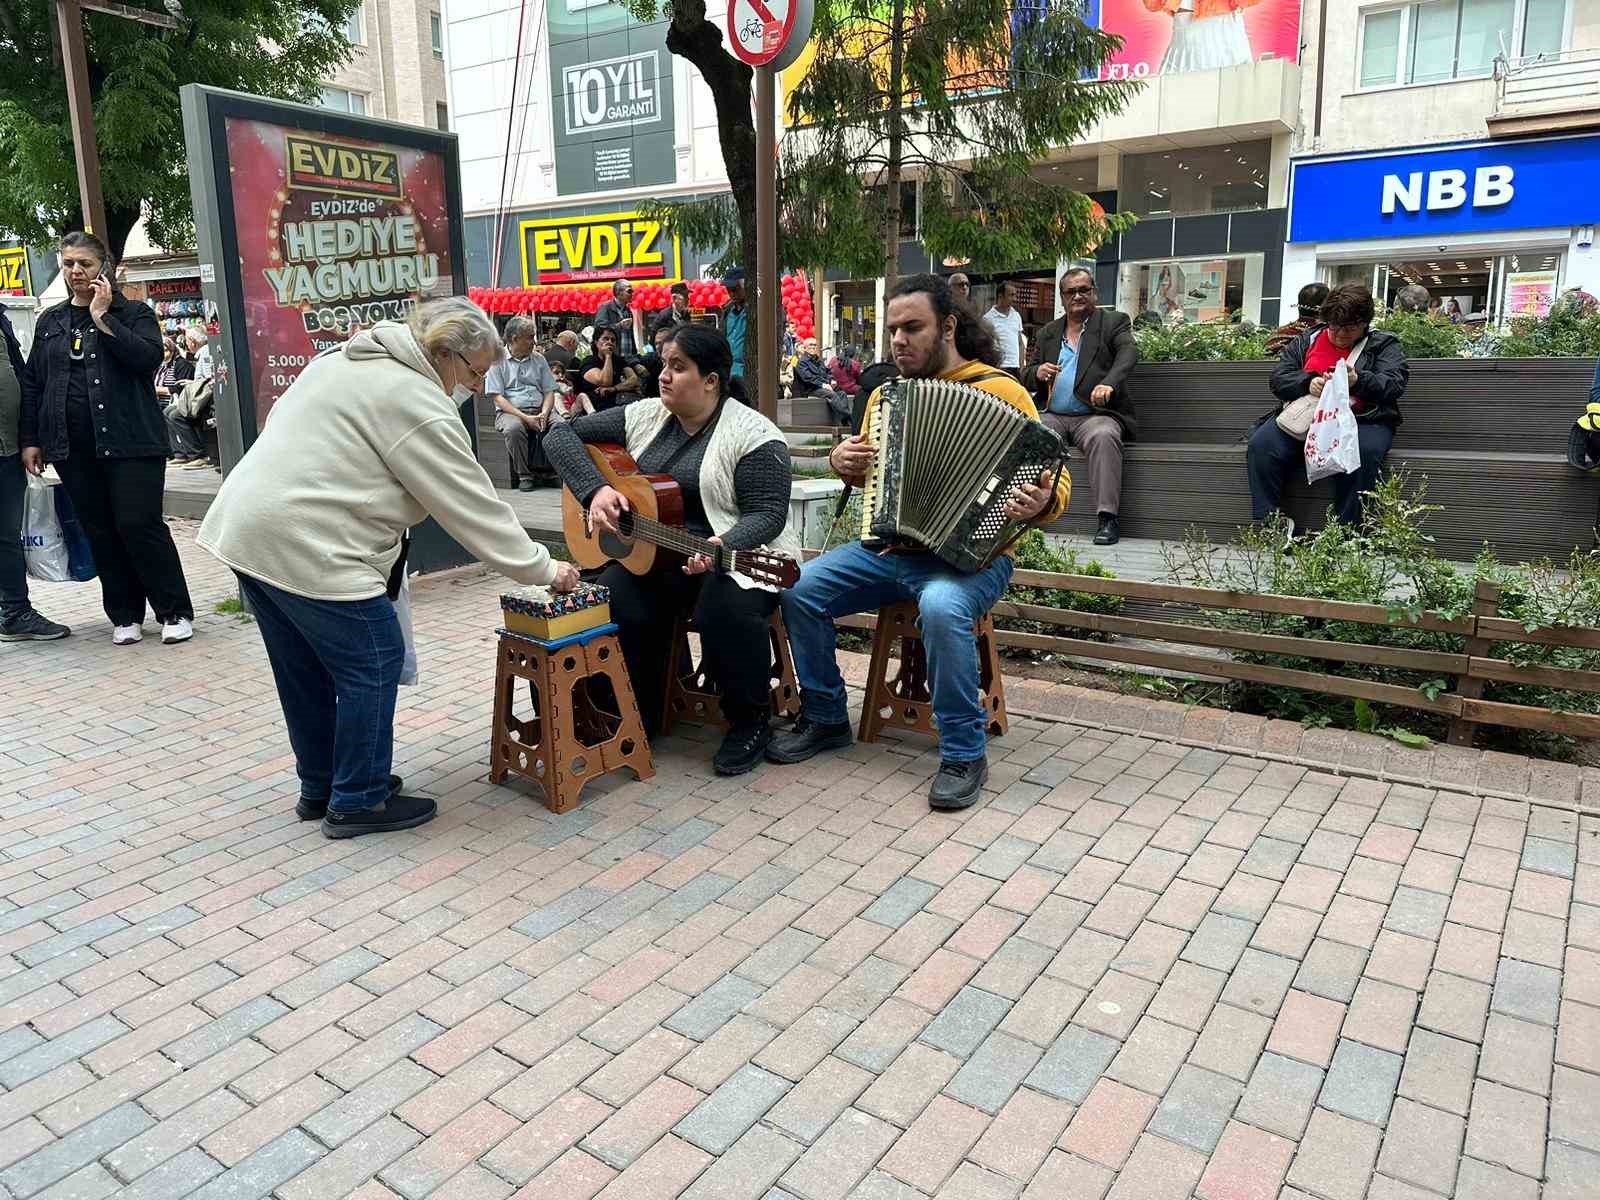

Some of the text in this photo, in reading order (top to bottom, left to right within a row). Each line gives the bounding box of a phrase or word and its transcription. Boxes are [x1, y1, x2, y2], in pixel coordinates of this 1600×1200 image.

[568, 60, 654, 127] 10 YIL
[1381, 165, 1514, 213] NBB
[0, 256, 23, 289] iZ
[268, 355, 304, 367] 5.000
[271, 374, 297, 386] 10.0
